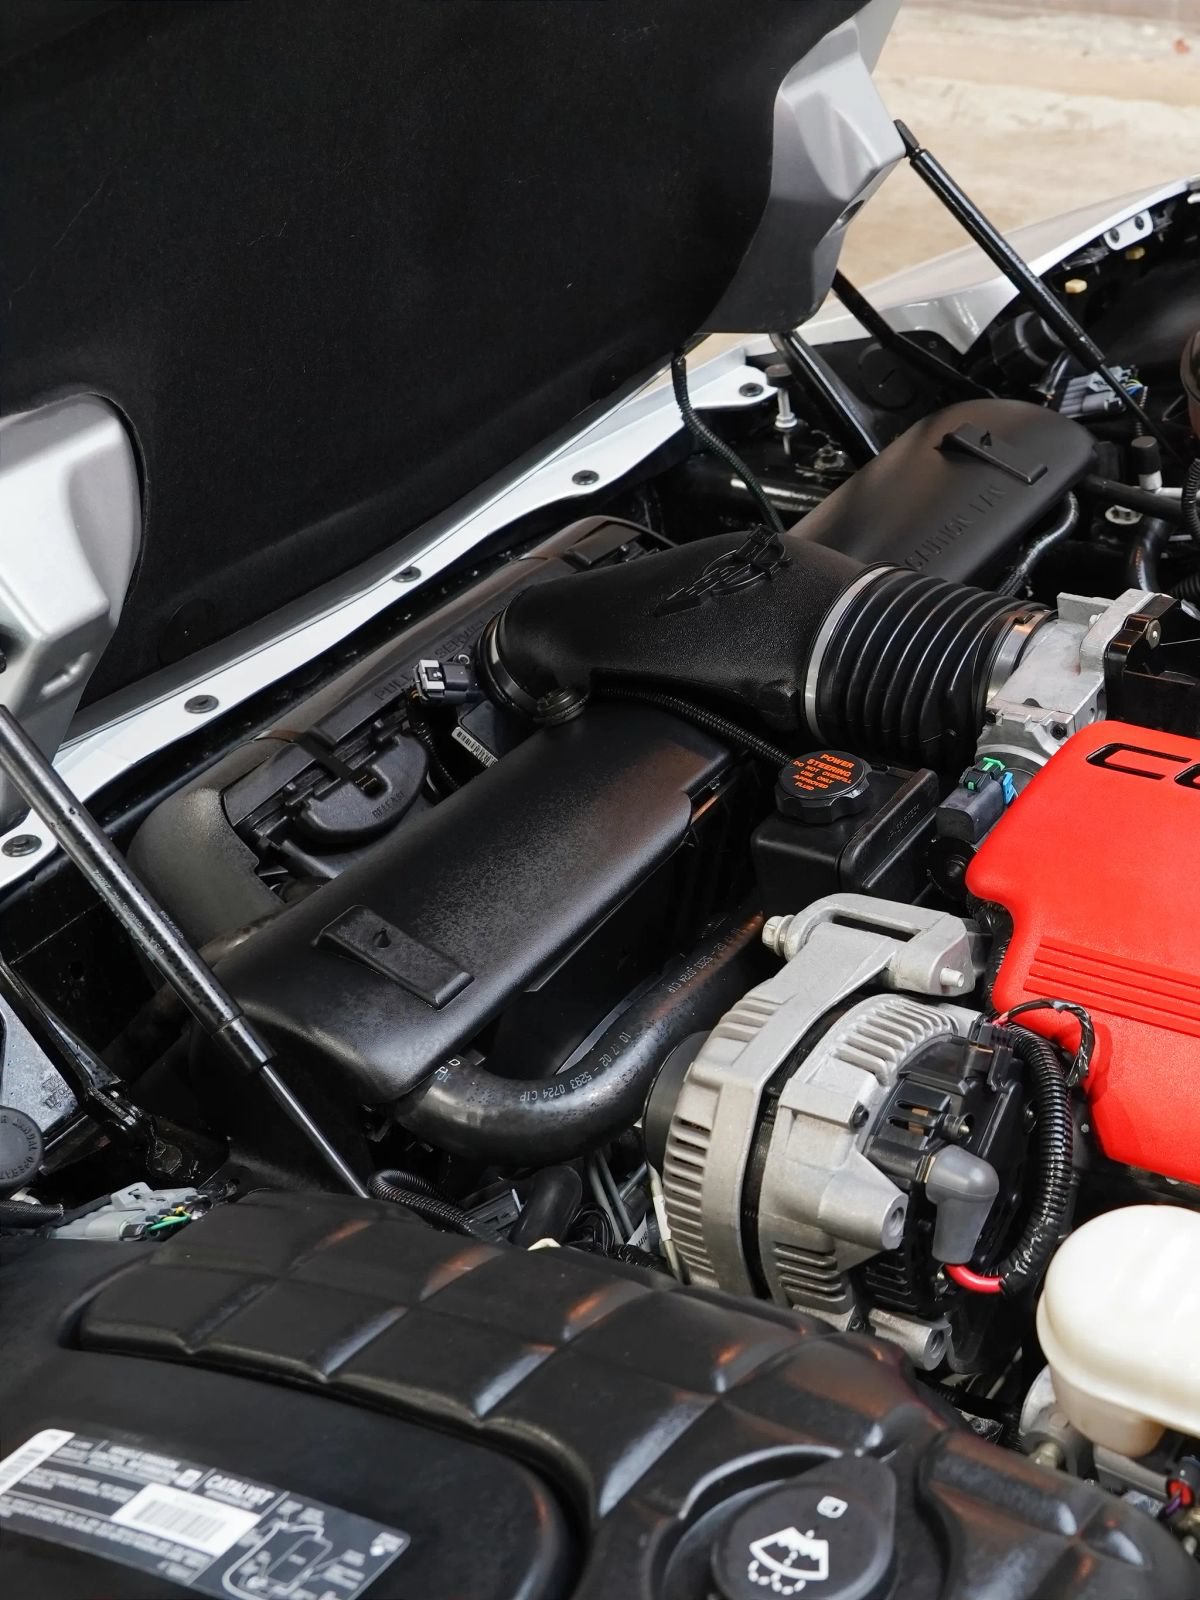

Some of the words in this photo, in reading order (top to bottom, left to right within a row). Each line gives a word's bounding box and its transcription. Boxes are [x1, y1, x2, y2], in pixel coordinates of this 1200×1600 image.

[904, 514, 973, 572] CAUTION
[806, 758, 852, 777] STEERING
[820, 753, 855, 769] POWER
[792, 774, 828, 789] APPROVED
[800, 770, 815, 778] USE
[816, 776, 834, 784] ONLY
[805, 765, 820, 773] NOT
[822, 771, 851, 784] OVERFILL
[794, 781, 815, 791] FLUID
[619, 1031, 631, 1044] 10
[600, 1055, 612, 1067] 02
[569, 1072, 592, 1089] 5293
[520, 1091, 538, 1102] CIP
[542, 1086, 566, 1099] 0724
[204, 1474, 275, 1506] CATALYST
